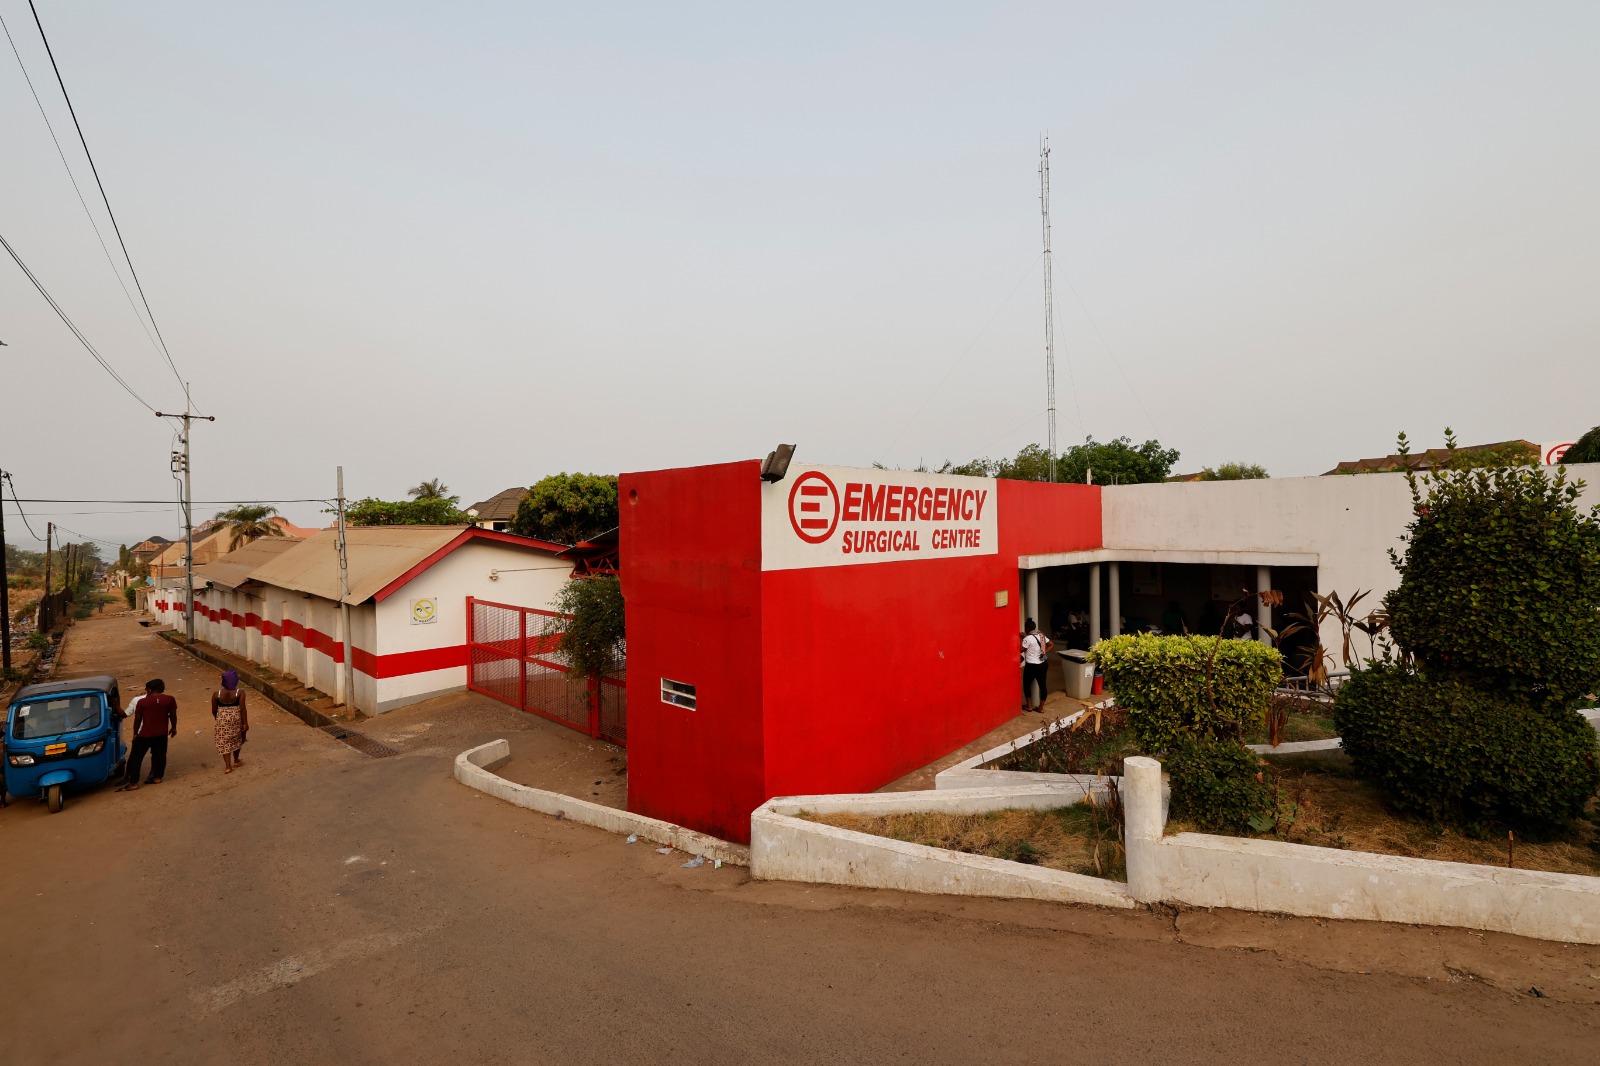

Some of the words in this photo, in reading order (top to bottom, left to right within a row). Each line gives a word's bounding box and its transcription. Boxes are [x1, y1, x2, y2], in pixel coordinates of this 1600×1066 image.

[842, 483, 988, 522] EMERGENCY
[842, 530, 920, 554] SURGICAL
[932, 529, 981, 549] CENTRE
